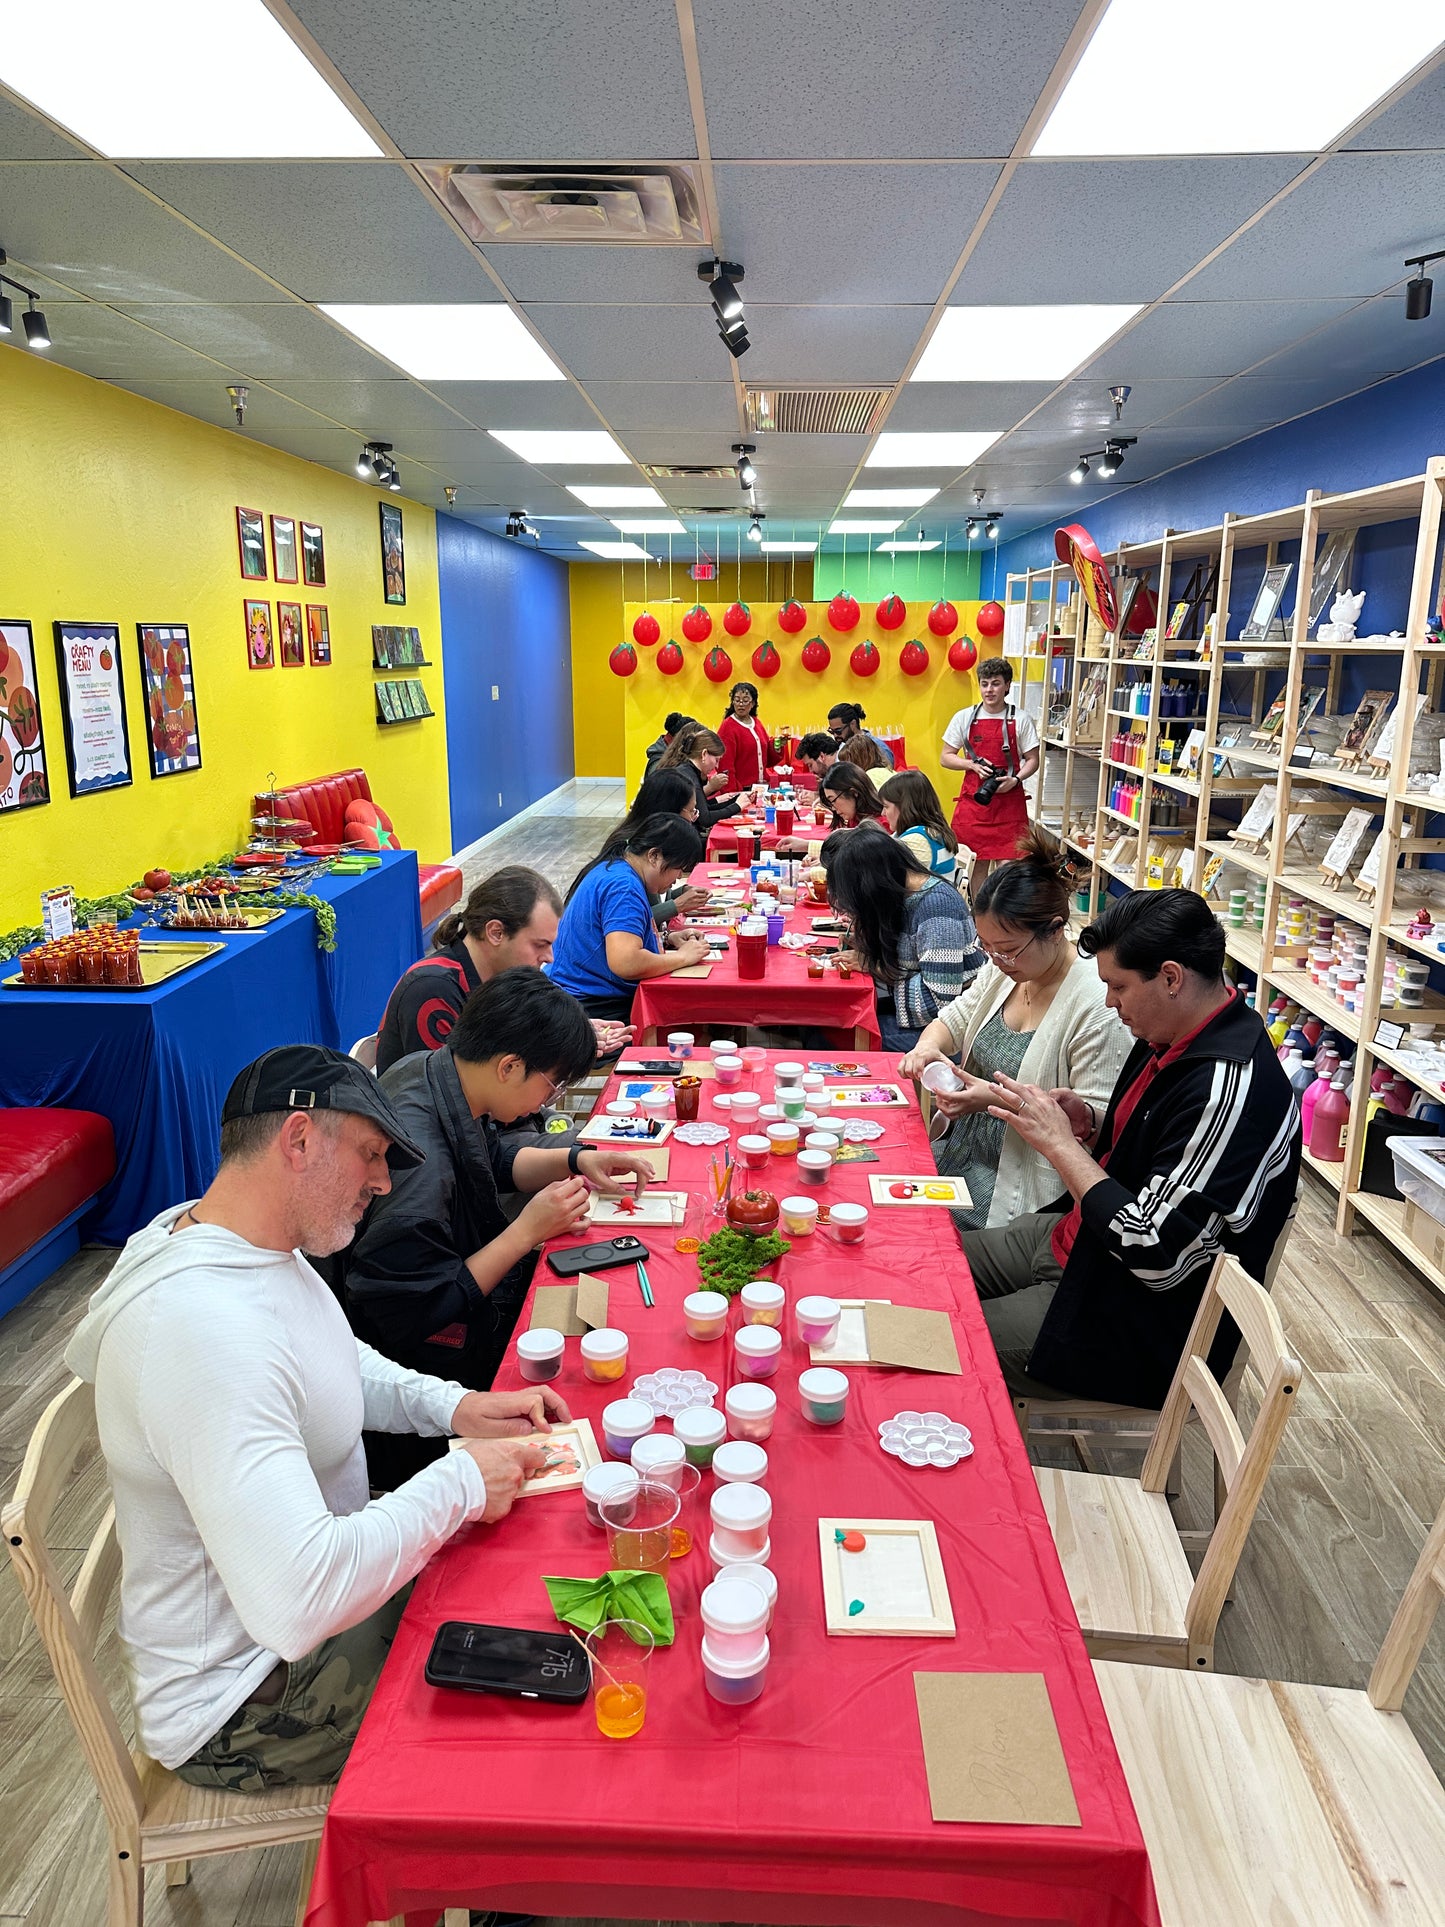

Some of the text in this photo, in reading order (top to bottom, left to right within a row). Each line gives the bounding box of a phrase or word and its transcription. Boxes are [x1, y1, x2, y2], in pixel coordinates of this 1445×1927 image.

[71, 644, 94, 659] CRAFTY
[72, 658, 92, 672] MENU
[540, 1648, 571, 1678] 7:15
